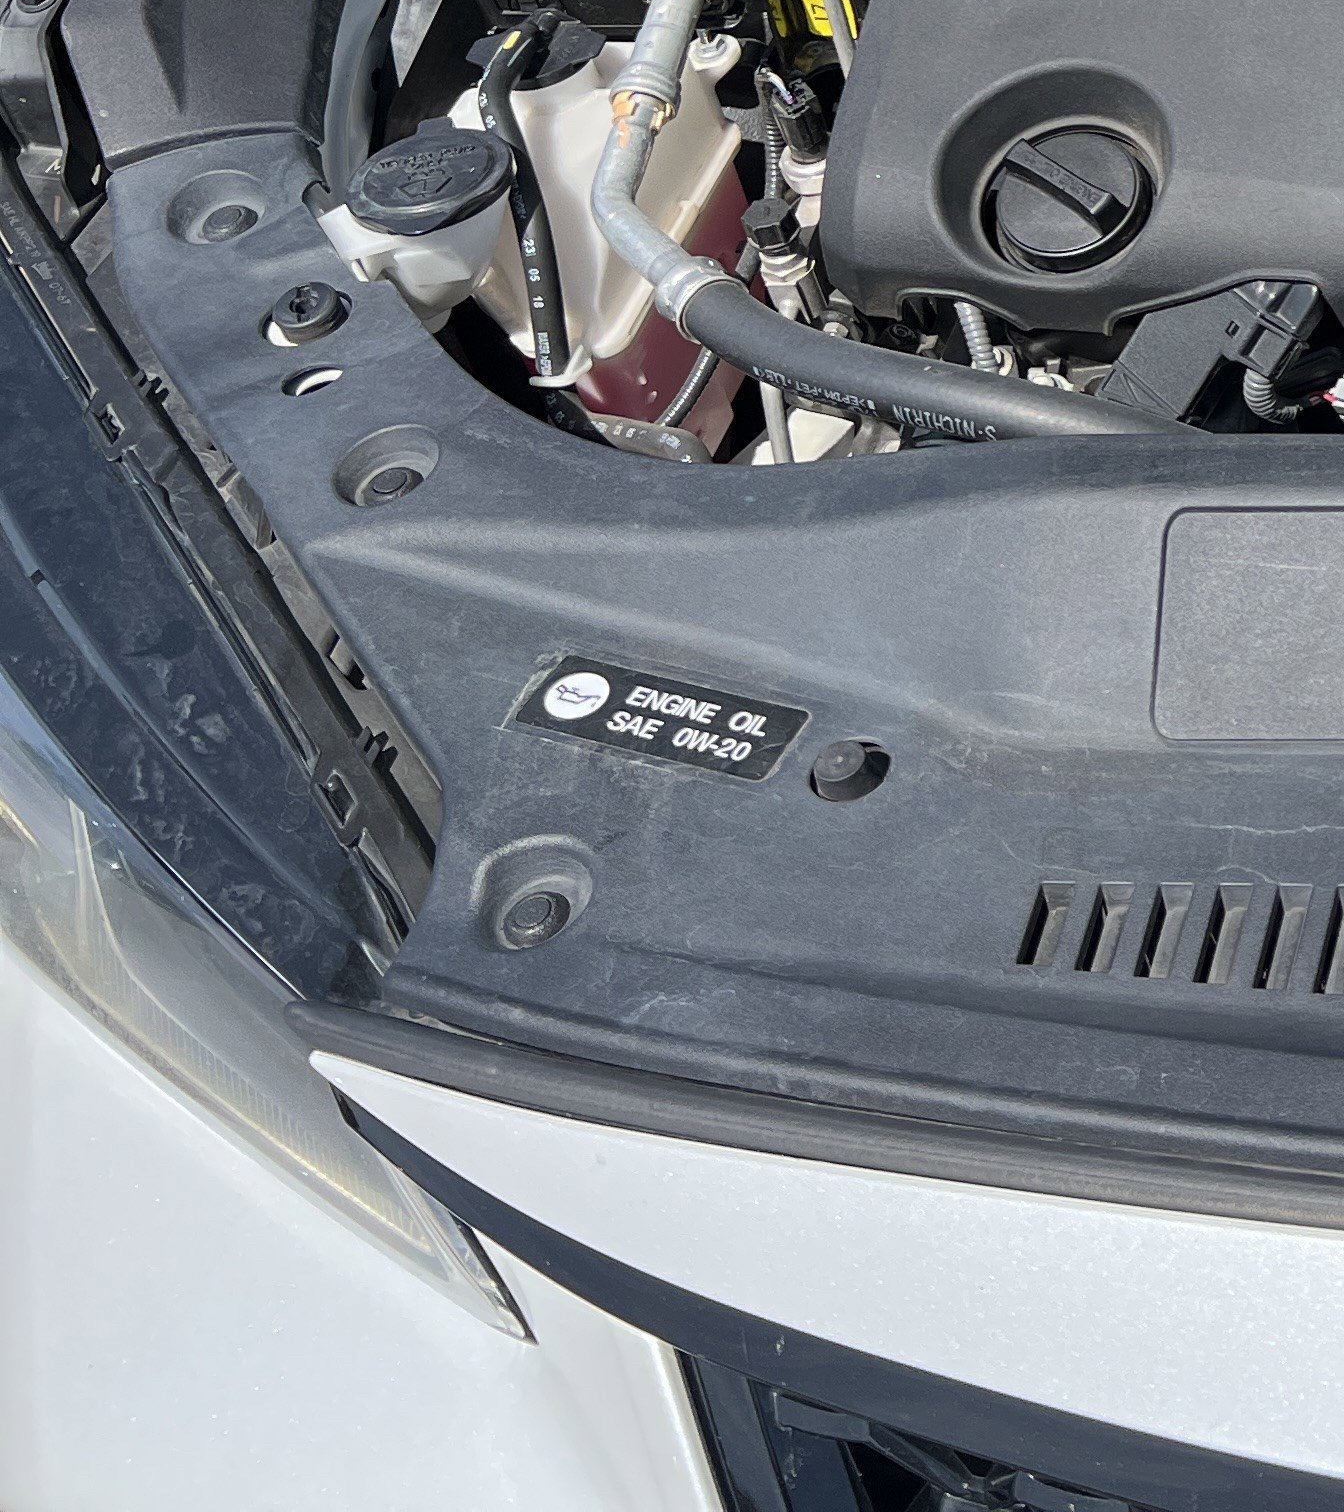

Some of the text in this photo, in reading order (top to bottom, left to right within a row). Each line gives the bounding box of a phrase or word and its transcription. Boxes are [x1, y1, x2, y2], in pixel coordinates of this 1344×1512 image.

[606, 710, 752, 762] SAE 0W-20
[625, 685, 768, 738] ENGINE OIL
